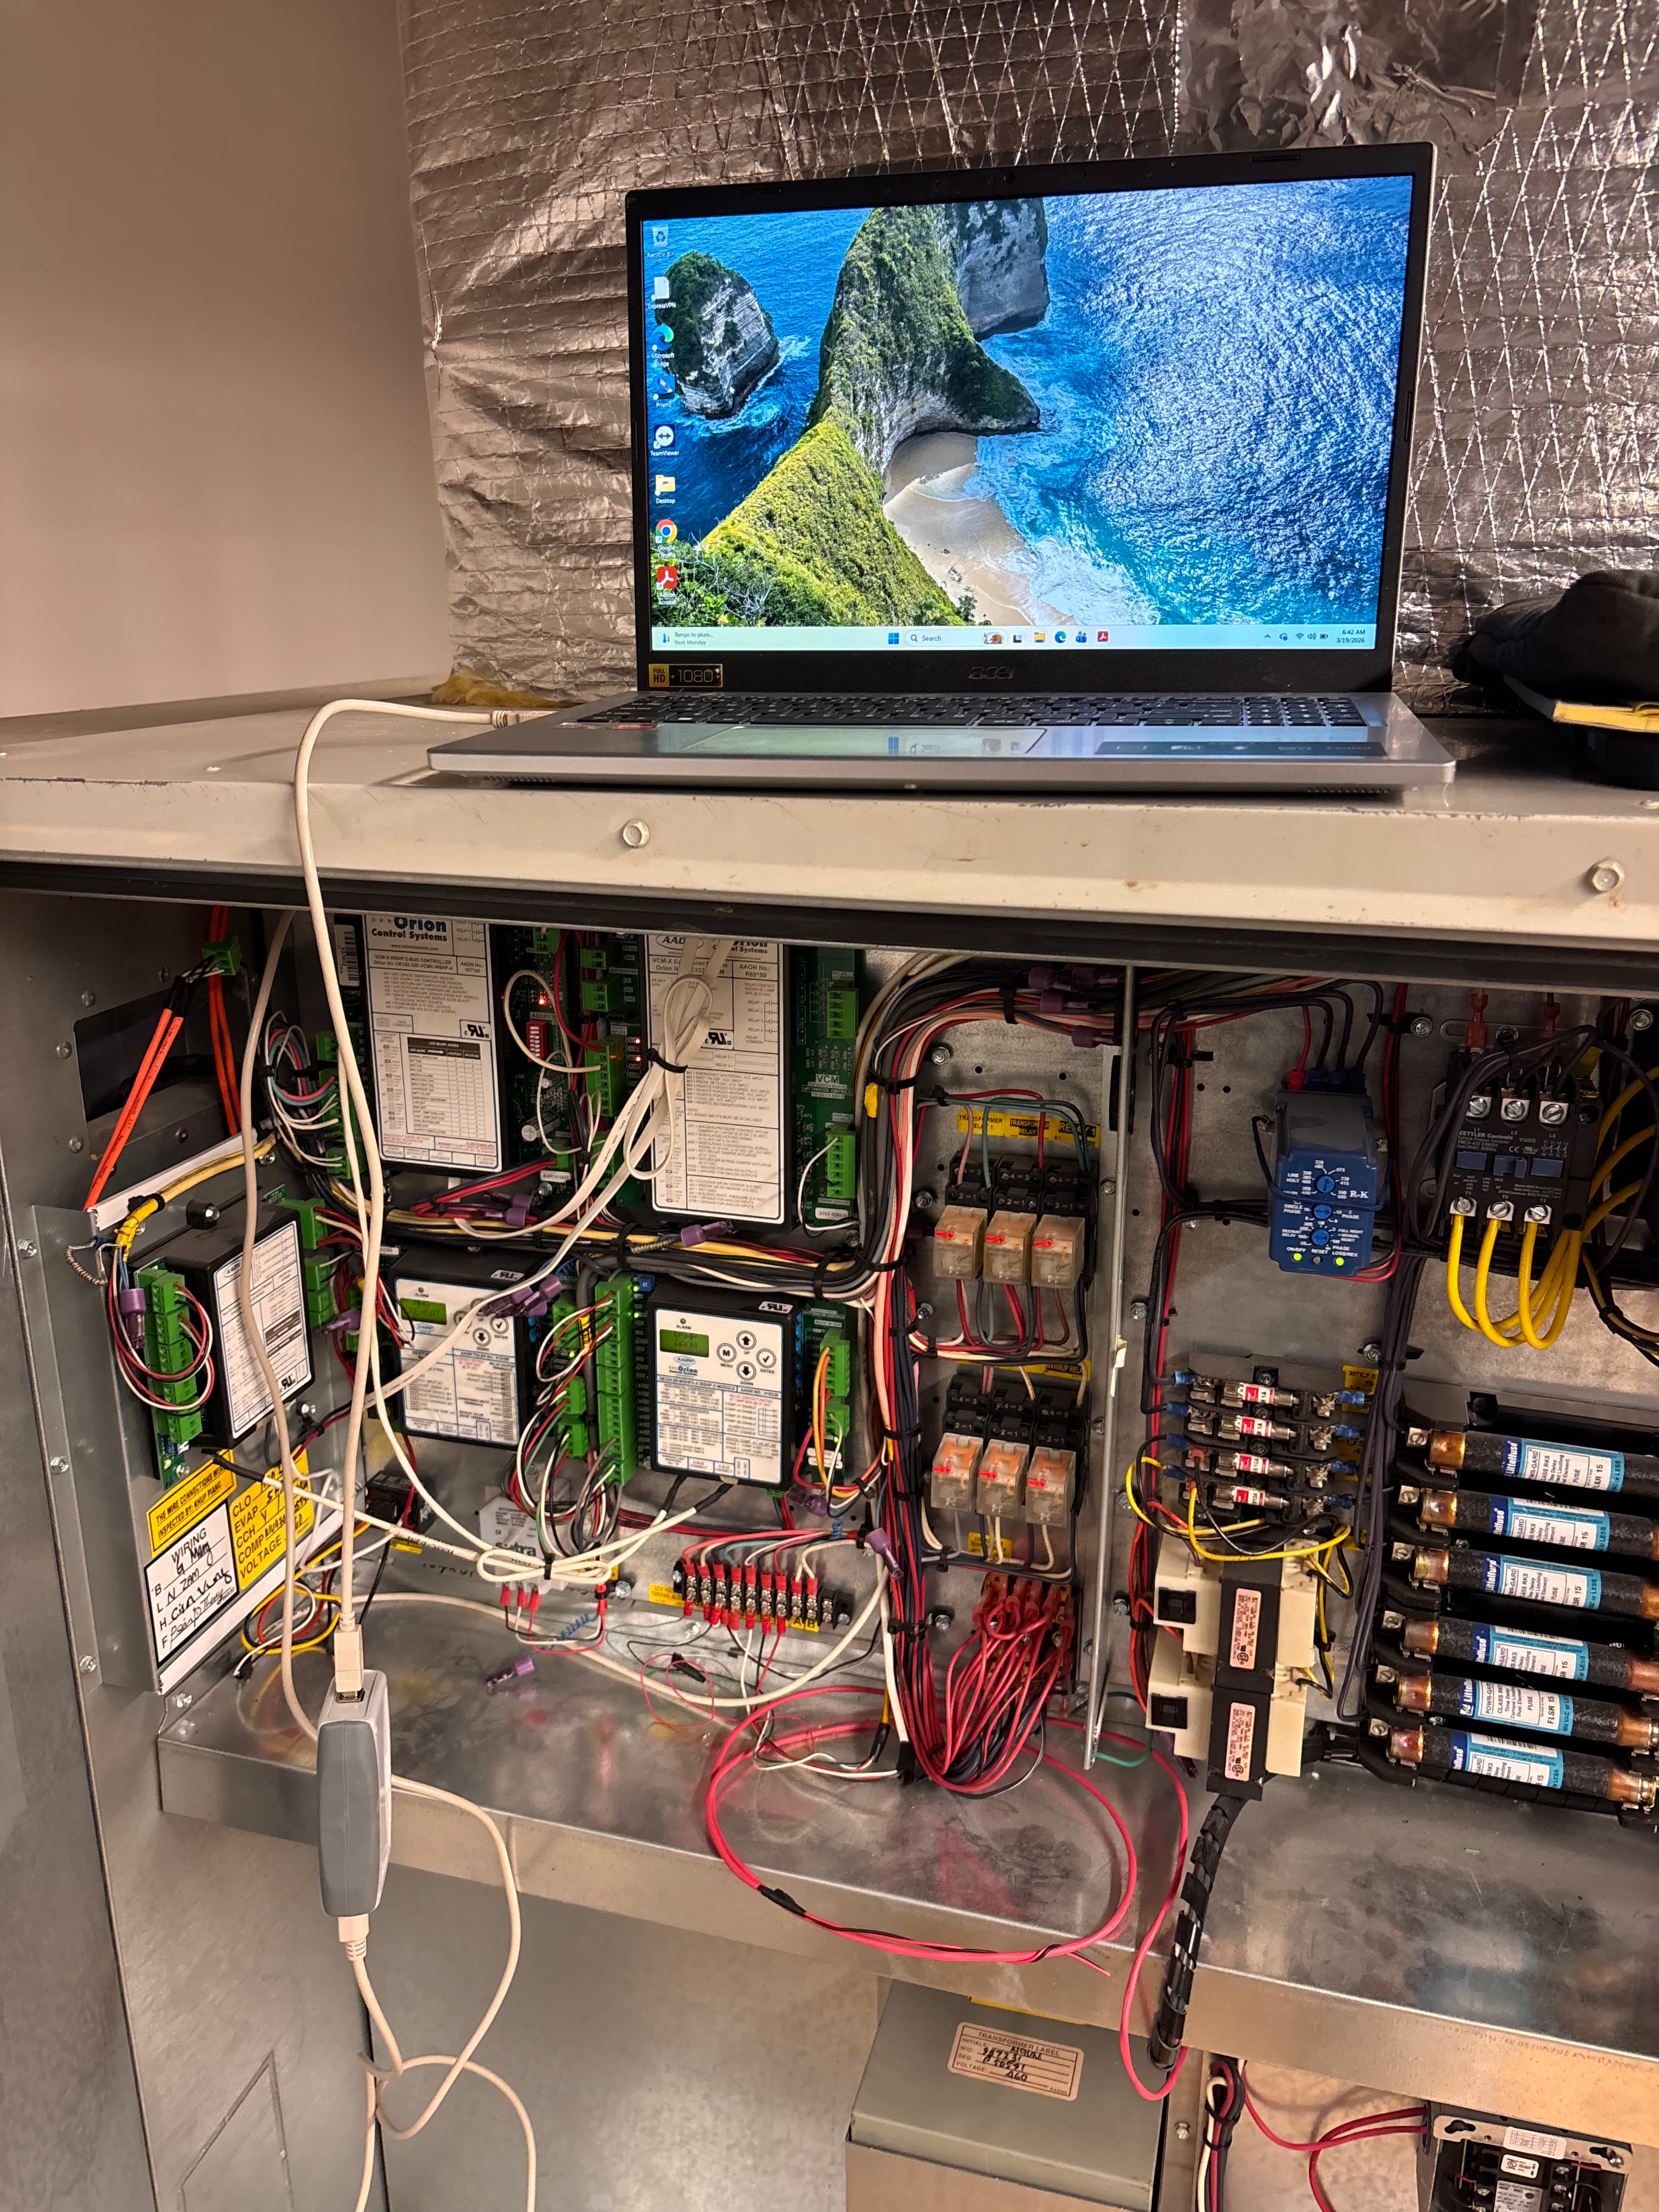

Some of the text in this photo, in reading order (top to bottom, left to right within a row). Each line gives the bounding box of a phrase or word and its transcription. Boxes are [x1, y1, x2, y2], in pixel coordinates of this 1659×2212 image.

[653, 674, 666, 683] HD
[968, 666, 1017, 681] acer
[394, 917, 447, 932] Orion
[371, 928, 447, 941] Control Systems
[816, 1074, 839, 1084] VCM
[675, 1340, 697, 1350] AAON
[156, 1472, 212, 1523] THE WIRE CONNECTIONS
[233, 1495, 251, 1517] CLO
[158, 1512, 184, 1538] INSPECTED
[185, 1506, 194, 1516] BY:
[194, 1493, 207, 1508] KHUP
[234, 1505, 258, 1534] EVAP
[236, 1525, 256, 1548] CCH
[171, 1528, 207, 1563] WIRING
[238, 1534, 264, 1564] COMP
[240, 1534, 282, 1579] VOLTAGE
[155, 1583, 162, 1596] B
[1575, 1586, 1582, 1594] 15
[157, 1603, 163, 1613] L
[160, 1620, 167, 1630] H
[808, 1620, 815, 1628] B
[162, 1635, 168, 1649] F
[978, 2032, 1034, 2049] TRANSFORMER
[1035, 2045, 1060, 2056] LABEL
